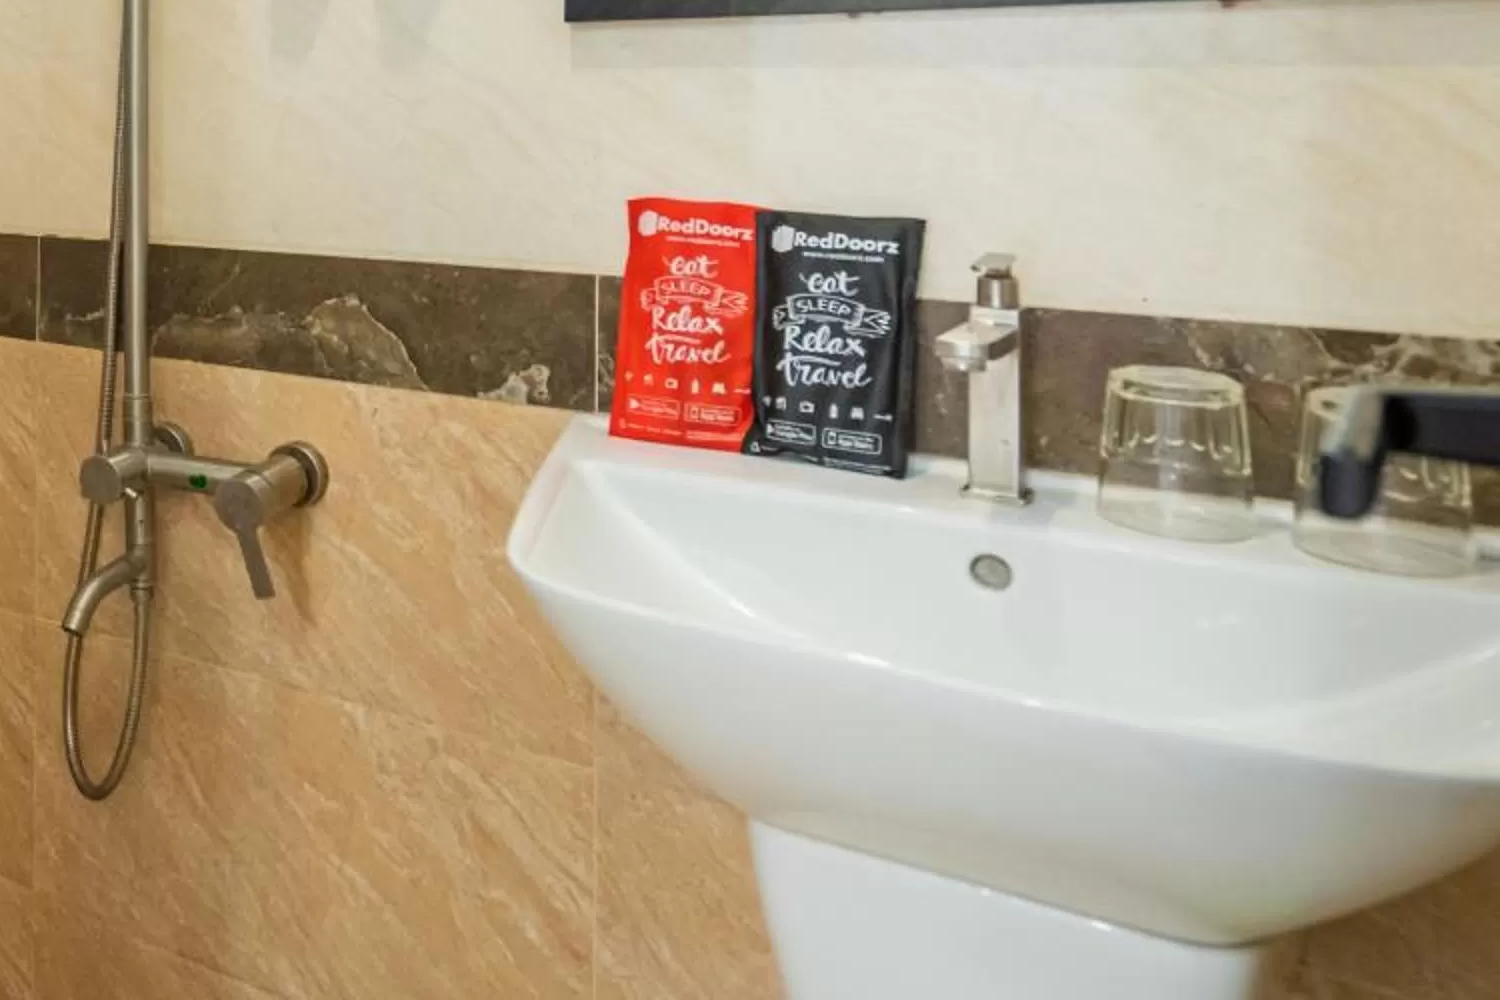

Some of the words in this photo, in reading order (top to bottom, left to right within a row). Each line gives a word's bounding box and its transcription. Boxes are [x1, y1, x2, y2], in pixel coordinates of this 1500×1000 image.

[658, 215, 754, 241] RedDoorz
[794, 231, 900, 255] RedDoorz
[796, 298, 852, 315] SLEEP
[651, 305, 724, 335] Relax
[784, 324, 866, 357] Relax
